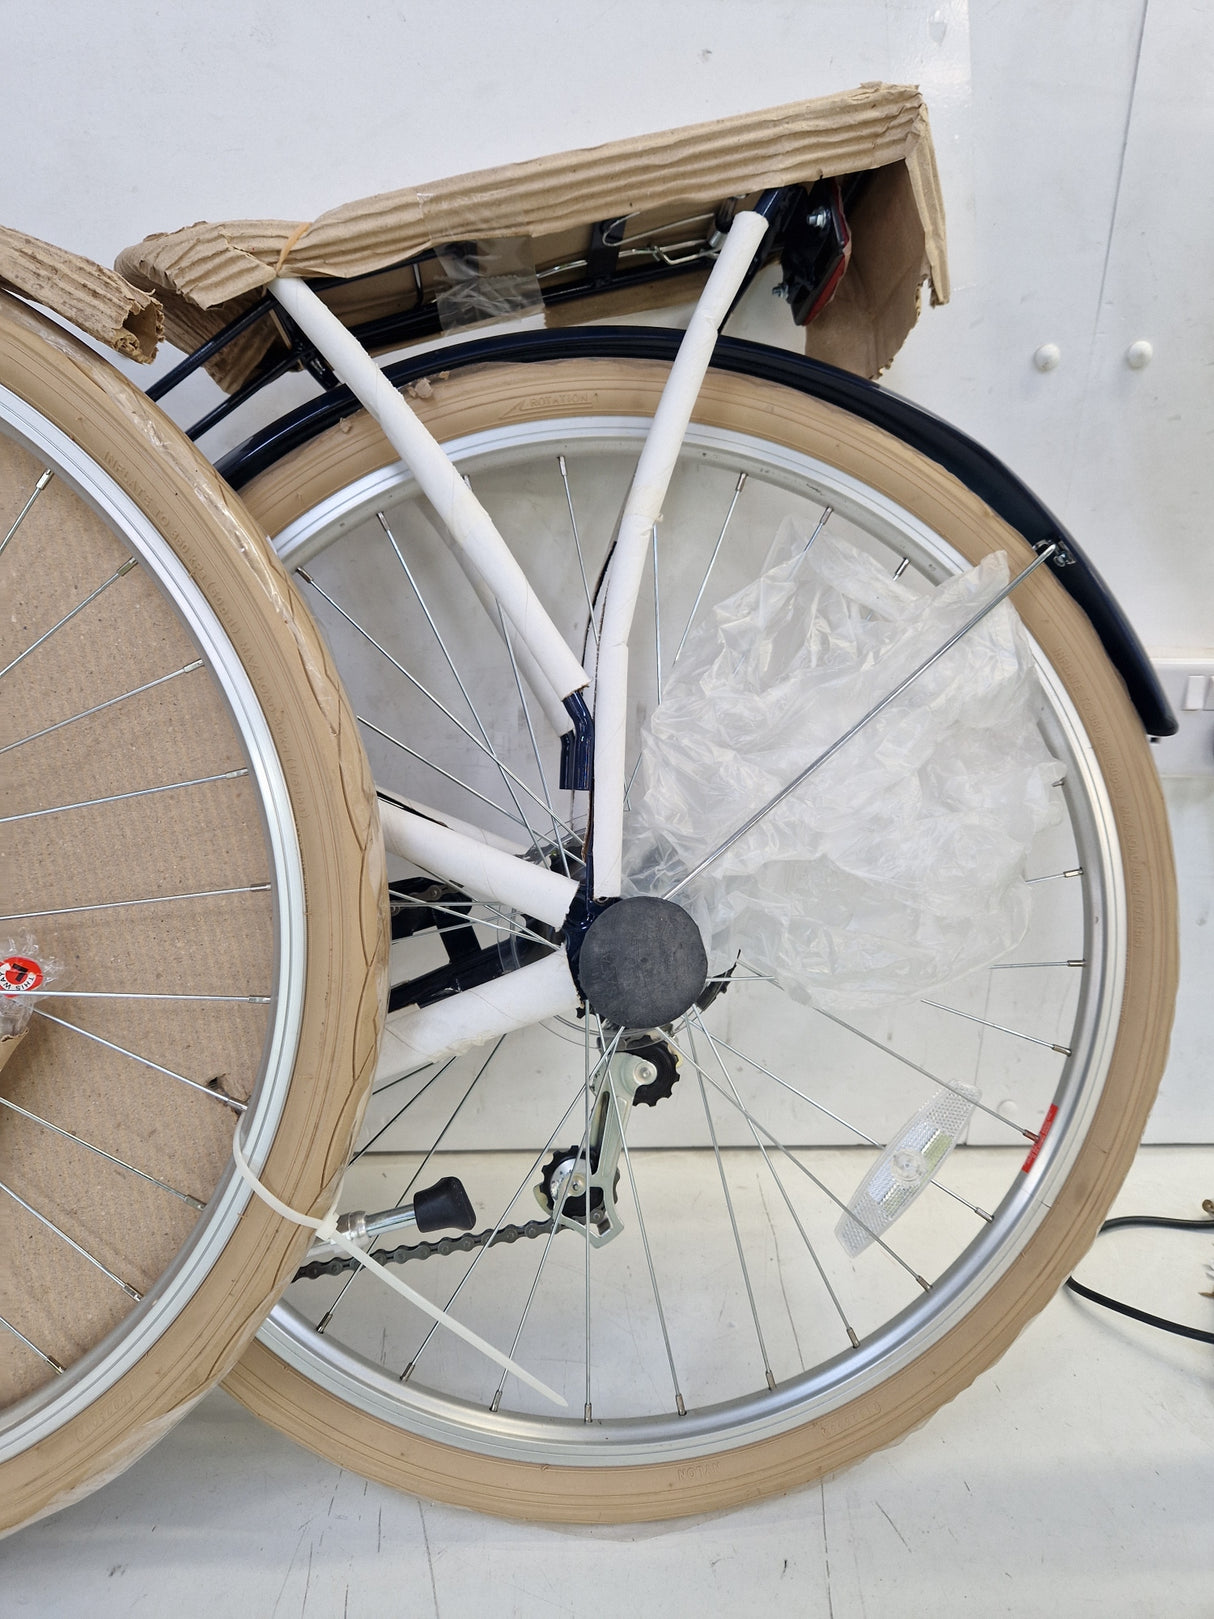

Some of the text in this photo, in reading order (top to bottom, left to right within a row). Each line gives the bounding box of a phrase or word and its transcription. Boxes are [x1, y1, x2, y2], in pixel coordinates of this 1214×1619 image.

[529, 391, 589, 408] ROTATION
[15, 977, 35, 991] THIS
[677, 1462, 721, 1480] NYLON
